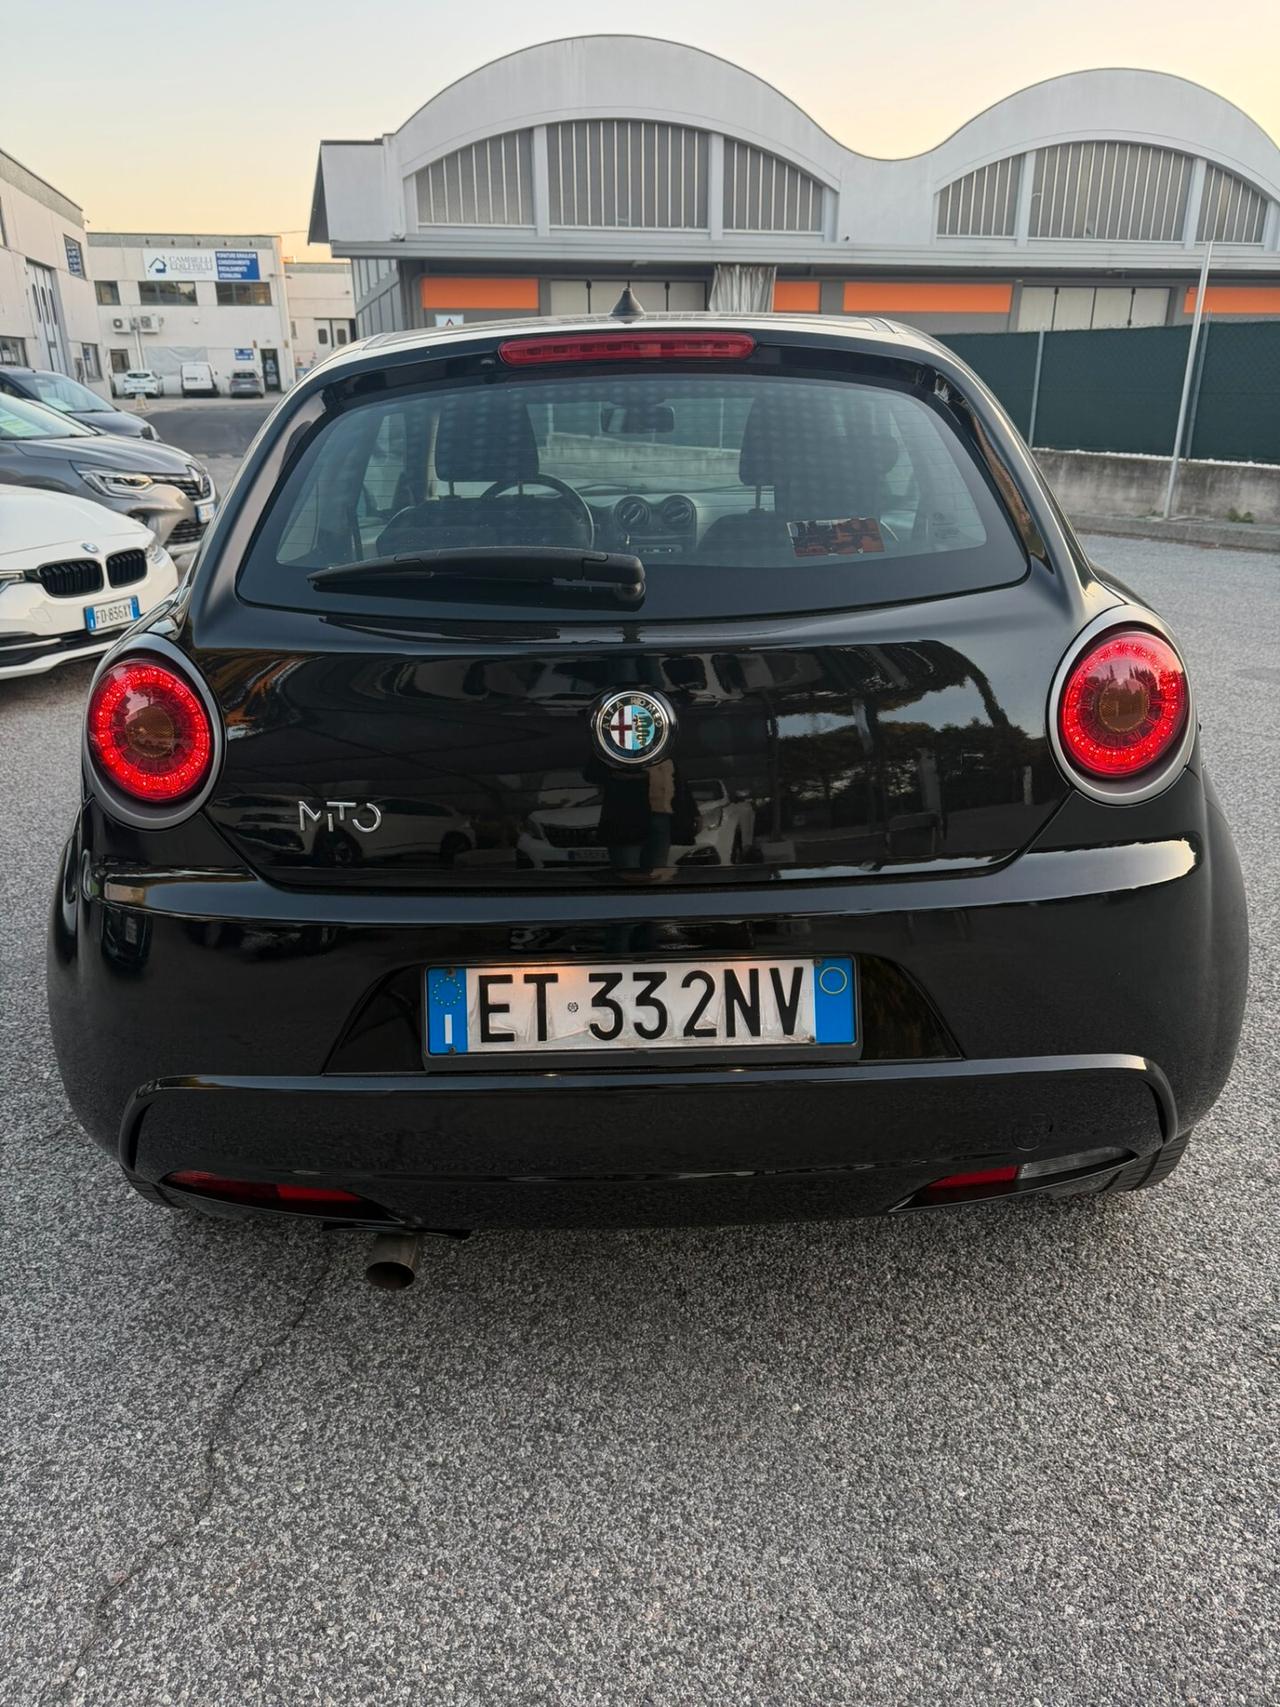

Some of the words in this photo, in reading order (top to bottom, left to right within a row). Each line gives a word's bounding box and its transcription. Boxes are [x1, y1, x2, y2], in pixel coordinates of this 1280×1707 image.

[96, 609, 107, 624] FD
[603, 700, 624, 730] ALFA
[630, 697, 663, 728] ROMEO
[478, 973, 559, 1044] ET
[588, 966, 804, 1041] 332NV
